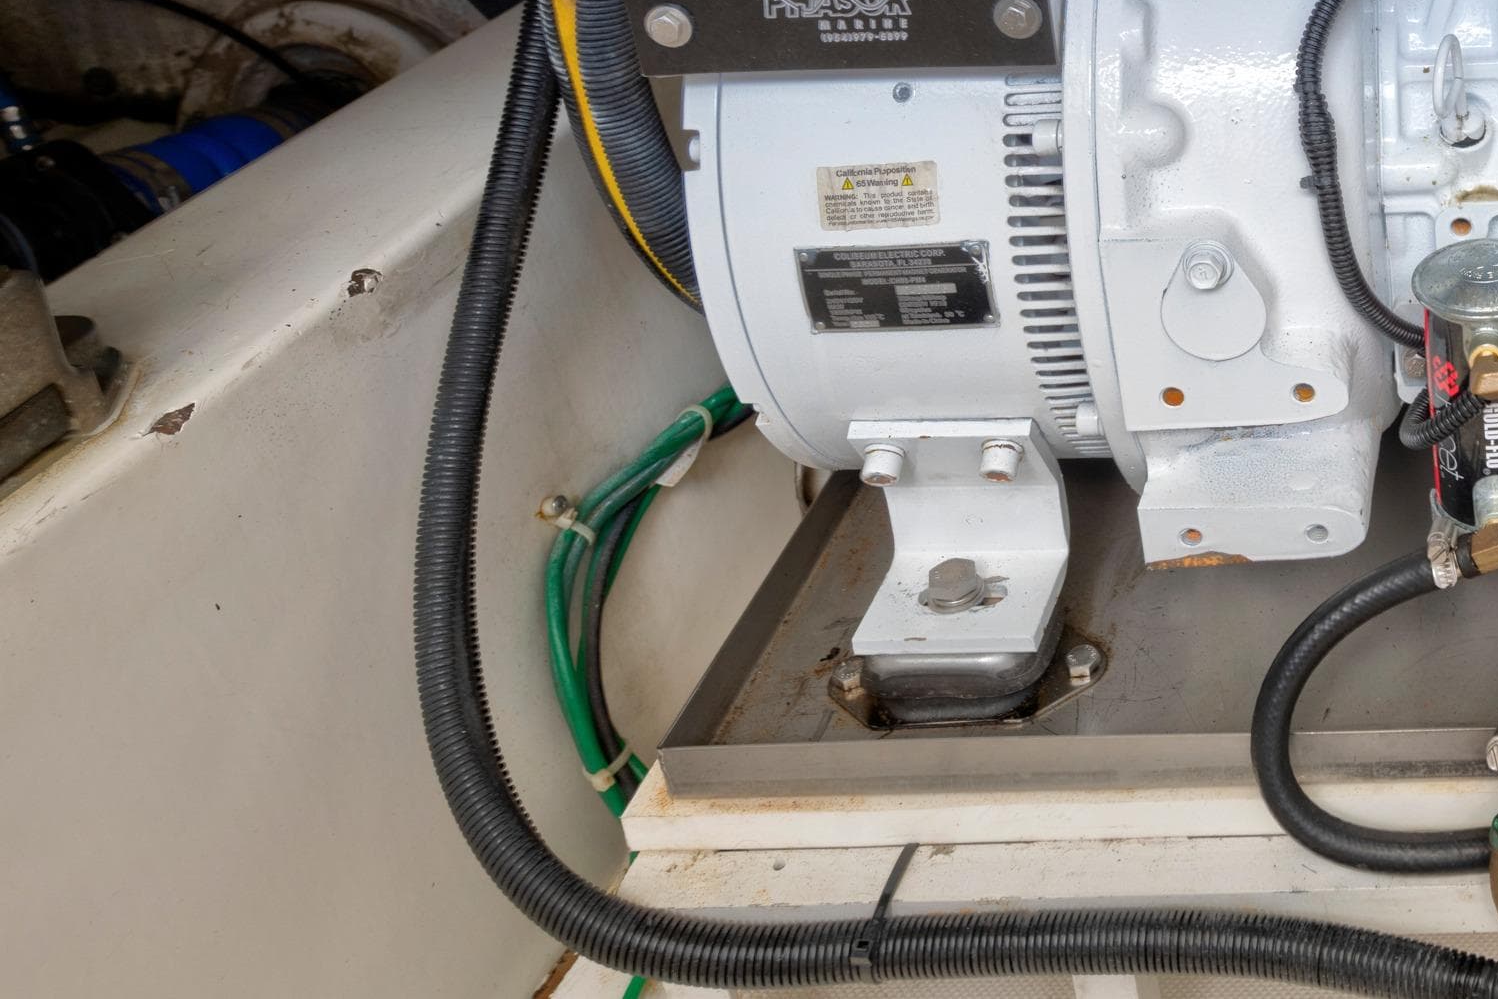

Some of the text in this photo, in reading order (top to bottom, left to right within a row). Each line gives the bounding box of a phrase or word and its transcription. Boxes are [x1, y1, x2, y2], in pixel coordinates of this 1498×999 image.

[818, 17, 908, 31] MARINE
[836, 165, 917, 178] California Proposition
[855, 178, 899, 188] 65 Warning
[878, 250, 920, 260] ELECTRIC
[921, 248, 946, 258] CORP.
